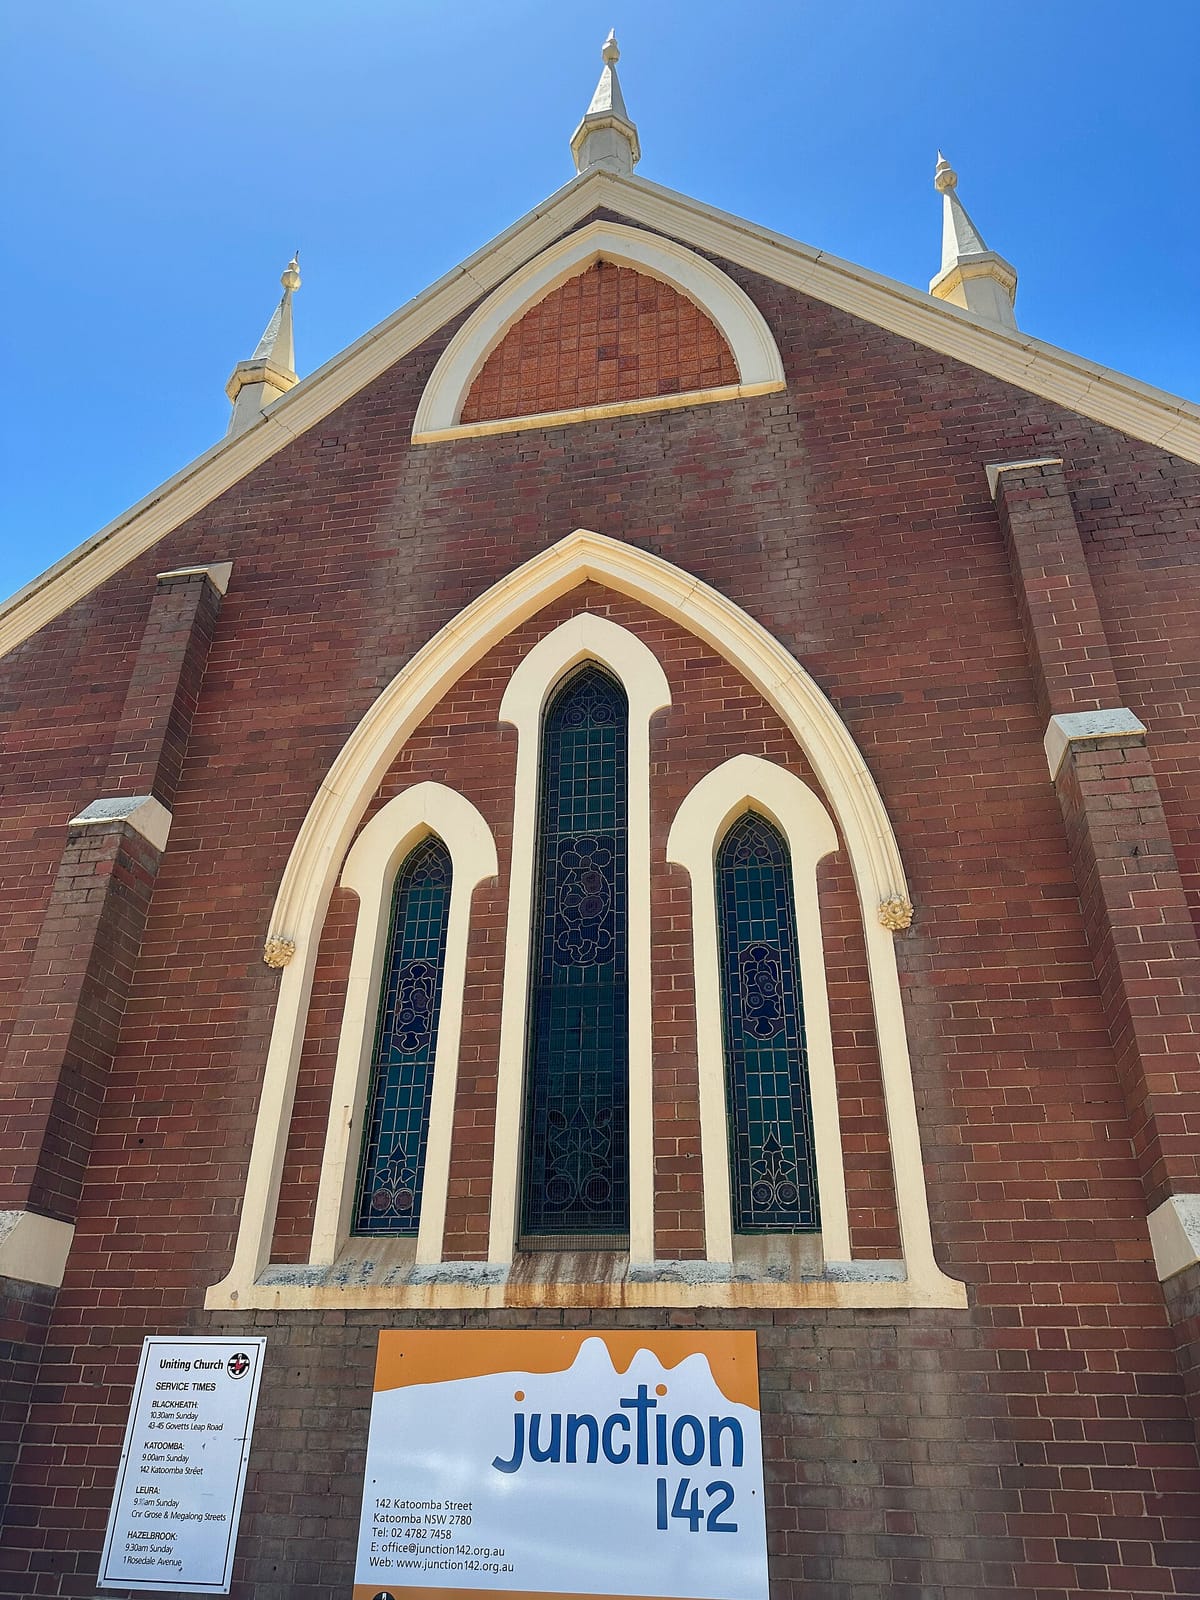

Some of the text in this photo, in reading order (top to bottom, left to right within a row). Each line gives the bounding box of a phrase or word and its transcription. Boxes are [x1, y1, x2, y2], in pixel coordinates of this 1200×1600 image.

[159, 1359, 224, 1371] Uniting Church
[155, 1382, 216, 1392] SERVICE TIMES
[152, 1401, 199, 1409] BLACKHEATH:
[176, 1412, 198, 1421] Sunday
[166, 1422, 190, 1430] Govetts
[190, 1423, 206, 1432] Leap
[492, 1383, 744, 1474] junction
[144, 1442, 185, 1450] KATOOMBA:
[166, 1454, 189, 1464] Sunday
[150, 1466, 184, 1474] Katoomba
[184, 1467, 204, 1475] Street
[136, 1486, 160, 1494] LEURA:
[156, 1499, 180, 1508] Sunday
[375, 1499, 472, 1510] 142 Katoomba Street
[656, 1478, 739, 1533] 142
[132, 1510, 142, 1518] Cnr
[144, 1511, 162, 1519] Grose
[170, 1512, 203, 1522] Megalong
[204, 1512, 226, 1521] Streets
[374, 1513, 472, 1526] Katoomba NSW 2780
[127, 1531, 178, 1540] HAZELBROOK:
[372, 1528, 452, 1540] Tel: 02 4782 7458
[150, 1544, 173, 1554] Sunday
[370, 1542, 505, 1558] E: office@junction142.org.au
[128, 1556, 156, 1564] Rosedale
[157, 1558, 182, 1566] Avenue
[370, 1557, 514, 1574] Web: www.junction142.org.au
